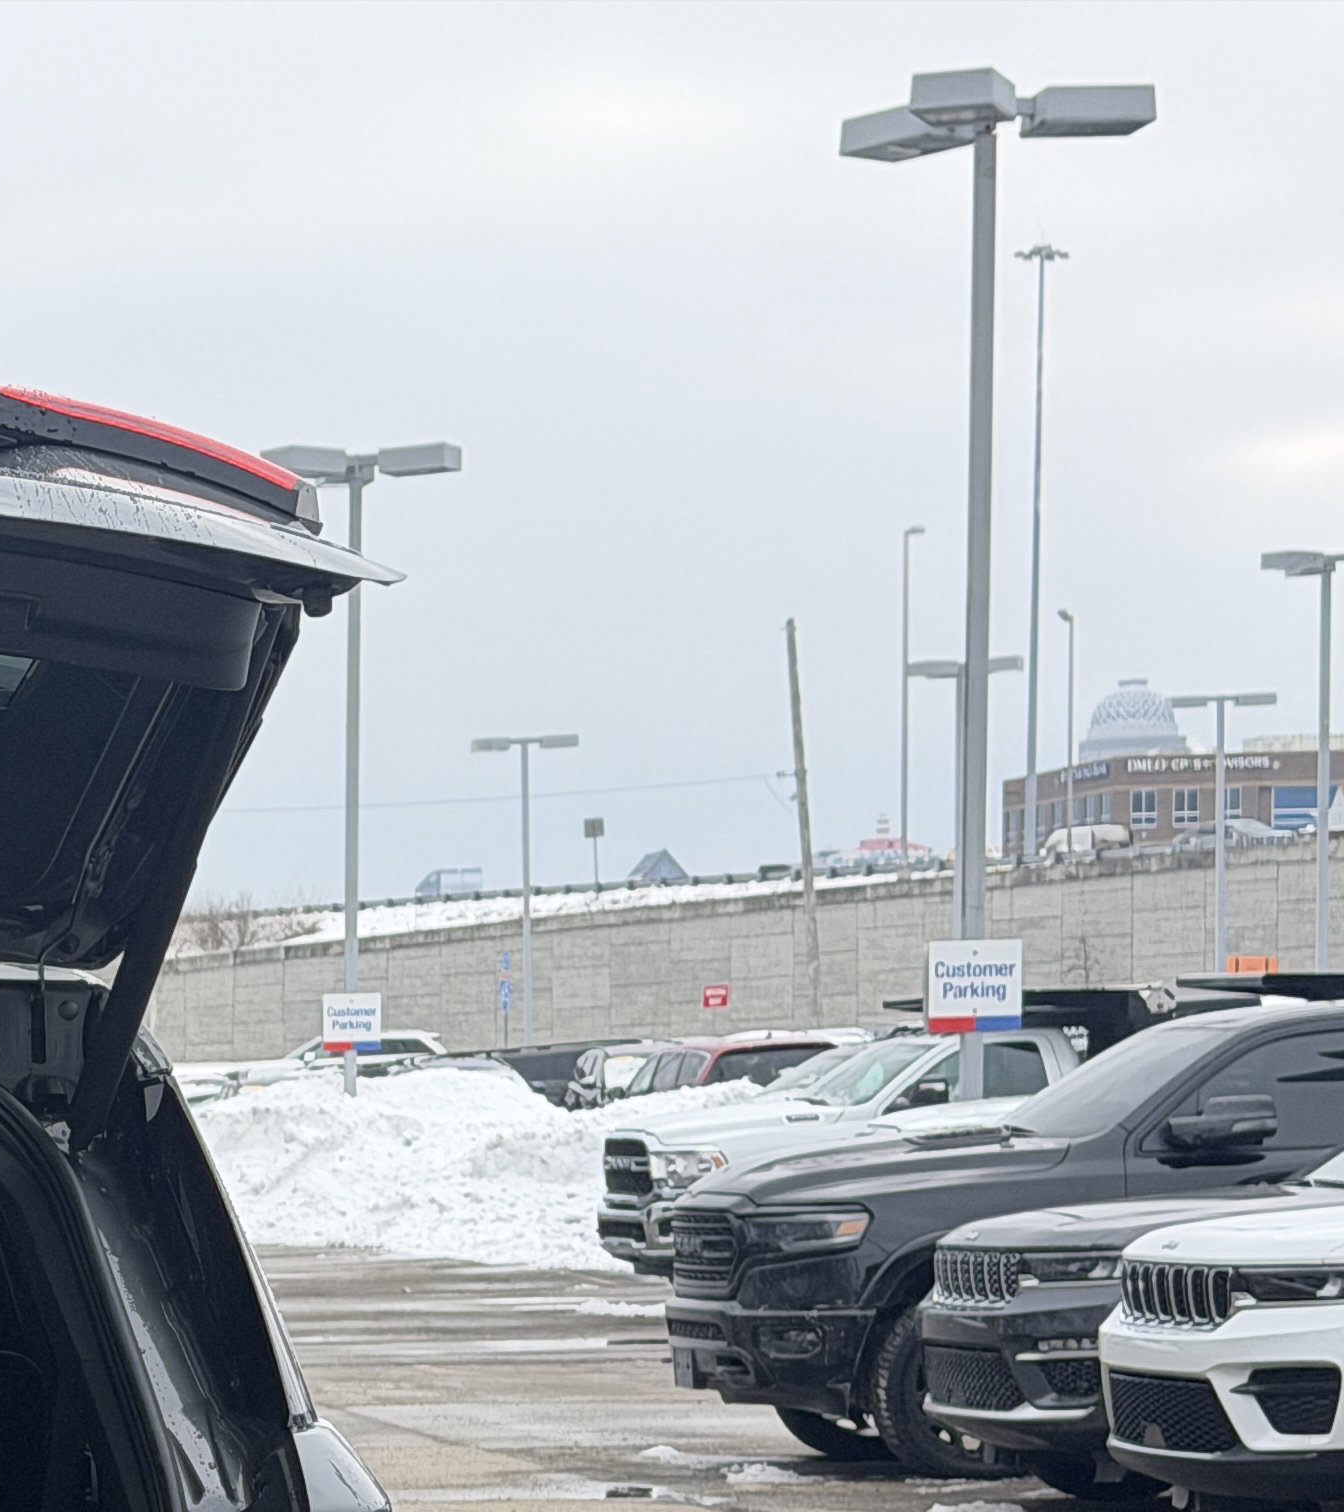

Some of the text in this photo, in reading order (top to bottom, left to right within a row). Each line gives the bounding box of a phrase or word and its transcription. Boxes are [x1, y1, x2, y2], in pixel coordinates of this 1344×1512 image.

[934, 961, 1016, 978] Customer
[942, 981, 1007, 1002] Parking
[327, 1006, 376, 1017] Customer
[332, 1019, 372, 1032] Parking
